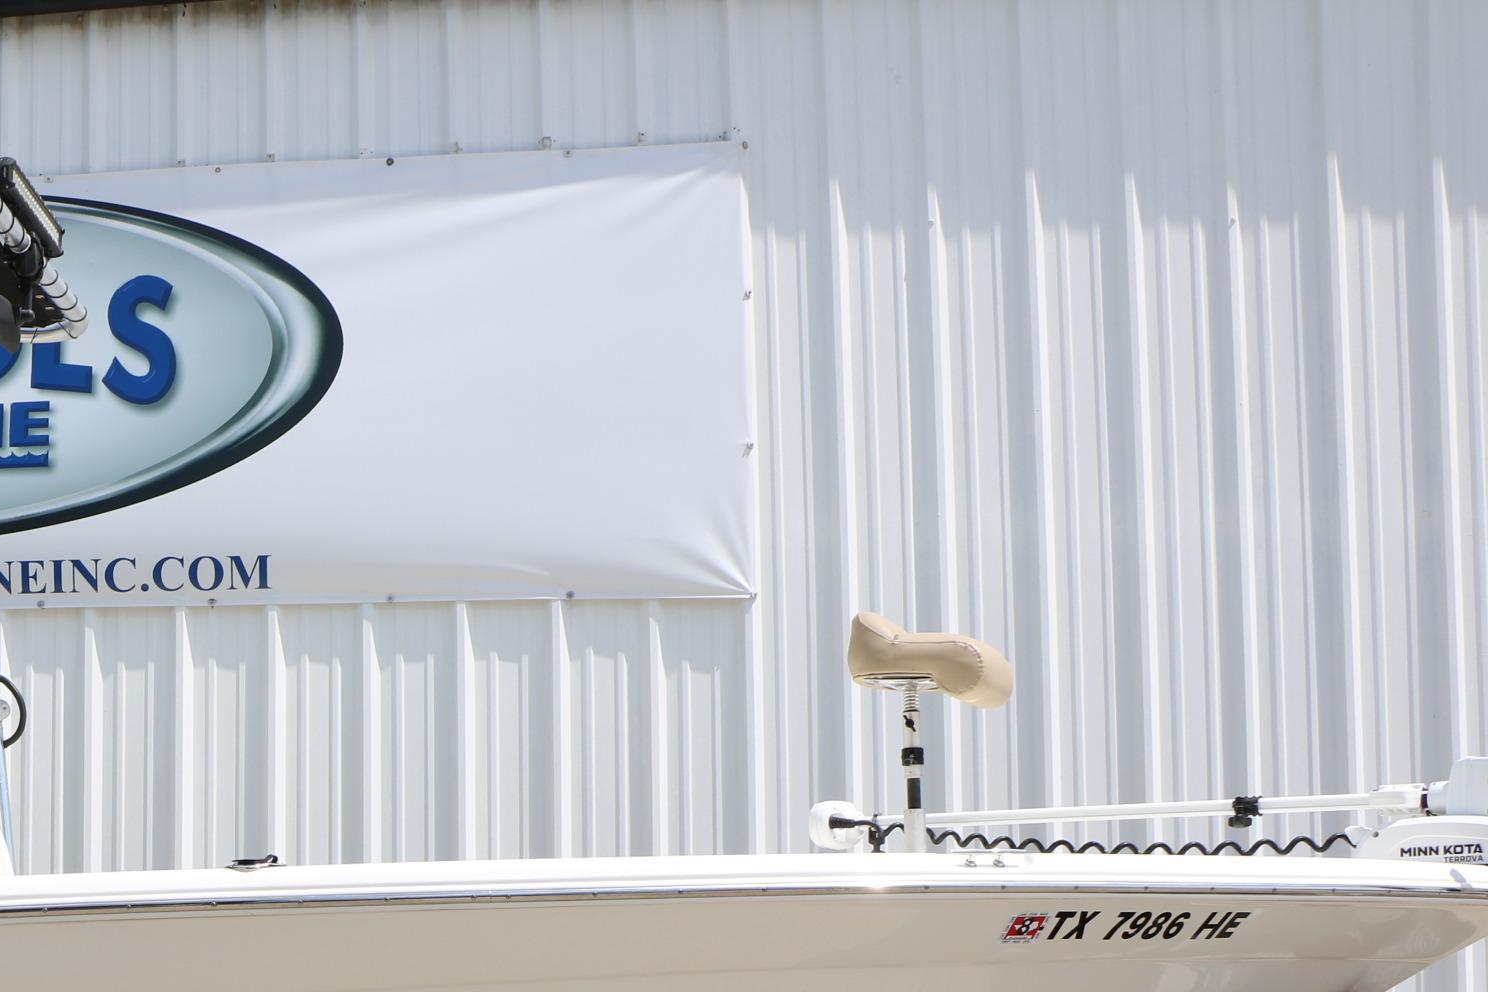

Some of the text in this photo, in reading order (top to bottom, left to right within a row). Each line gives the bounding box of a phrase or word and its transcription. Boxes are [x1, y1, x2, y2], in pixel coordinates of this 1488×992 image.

[1400, 843, 1483, 857] MINN KOTA
[1444, 855, 1483, 863] TERROVA
[1046, 911, 1252, 940] TX 7986 HE
